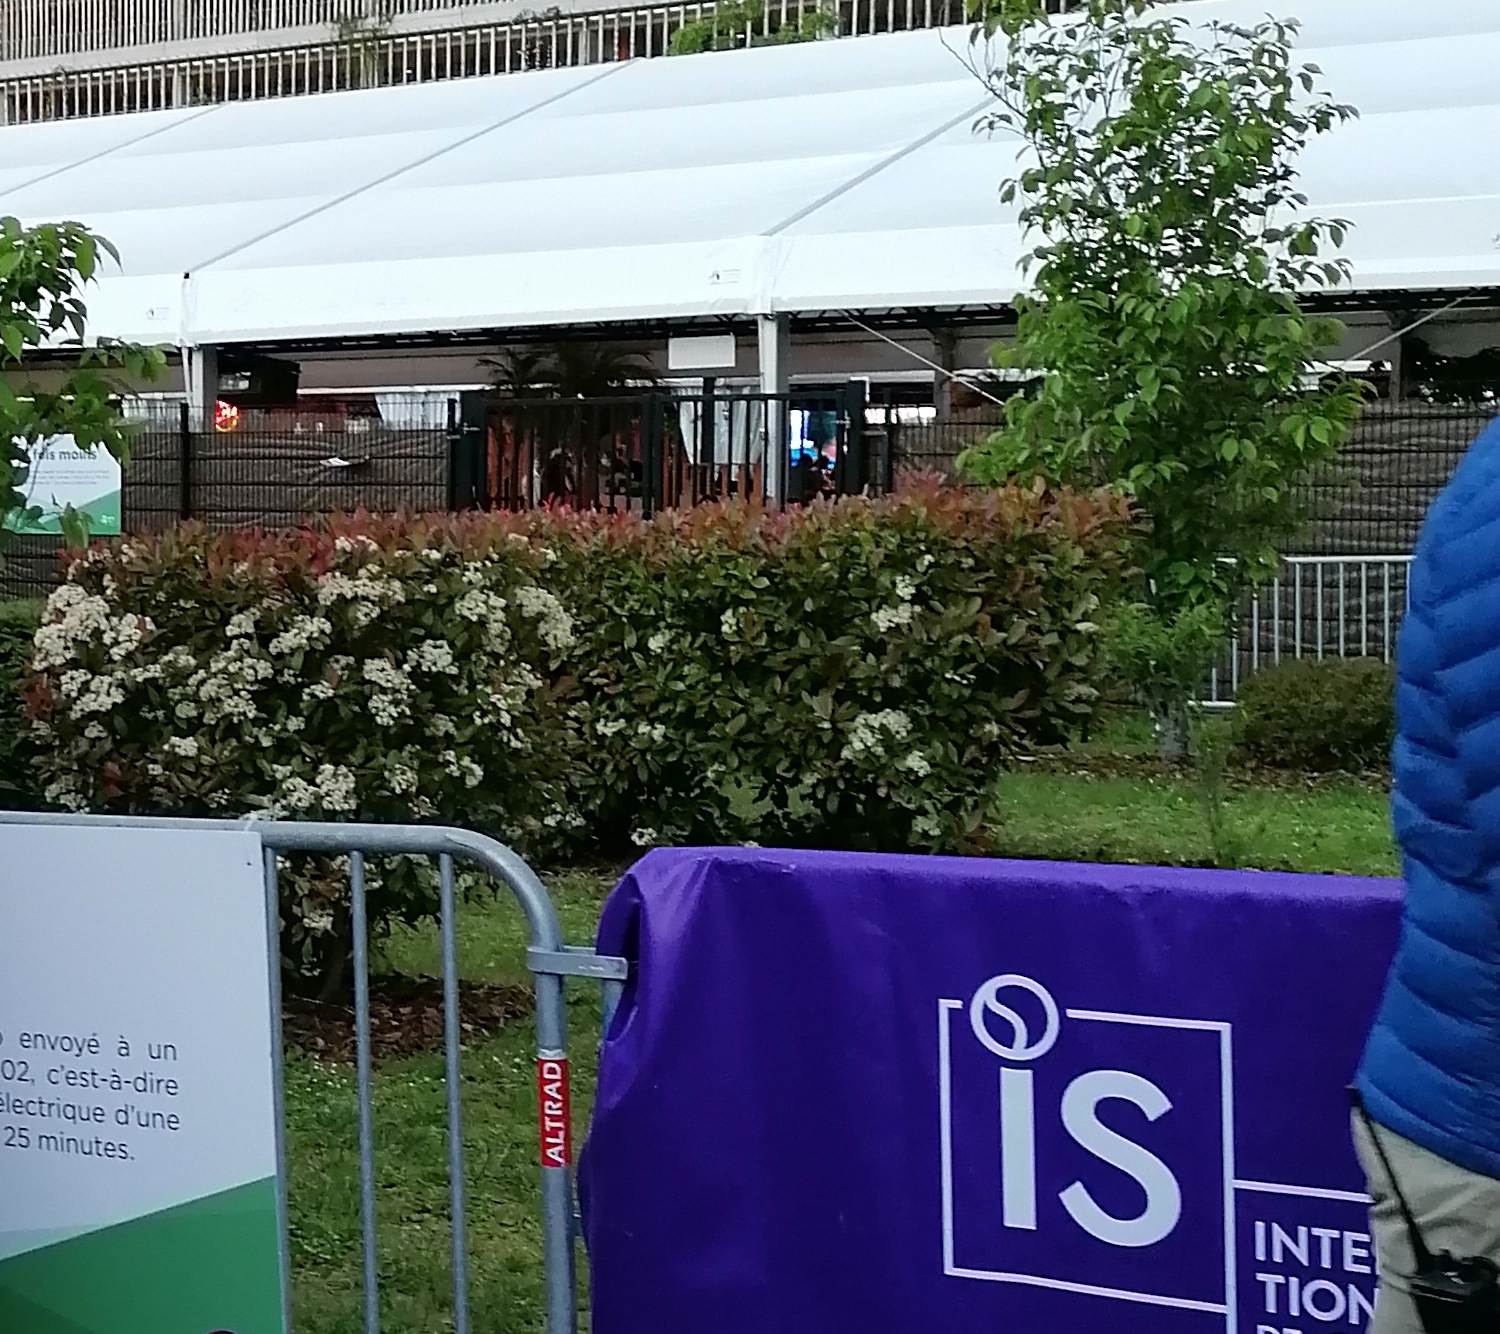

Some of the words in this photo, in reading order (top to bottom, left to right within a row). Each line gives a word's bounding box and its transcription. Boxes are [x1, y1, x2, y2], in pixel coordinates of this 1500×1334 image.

[19, 1031, 100, 1058] envoyé
[116, 1034, 131, 1058] à
[147, 1041, 178, 1062] un
[114, 1104, 181, 1131] d'une
[543, 1062, 566, 1164] ALTRAD
[3, 1125, 31, 1149] 25
[36, 1131, 137, 1161] minutes.
[1254, 1220, 1379, 1275] INTE
